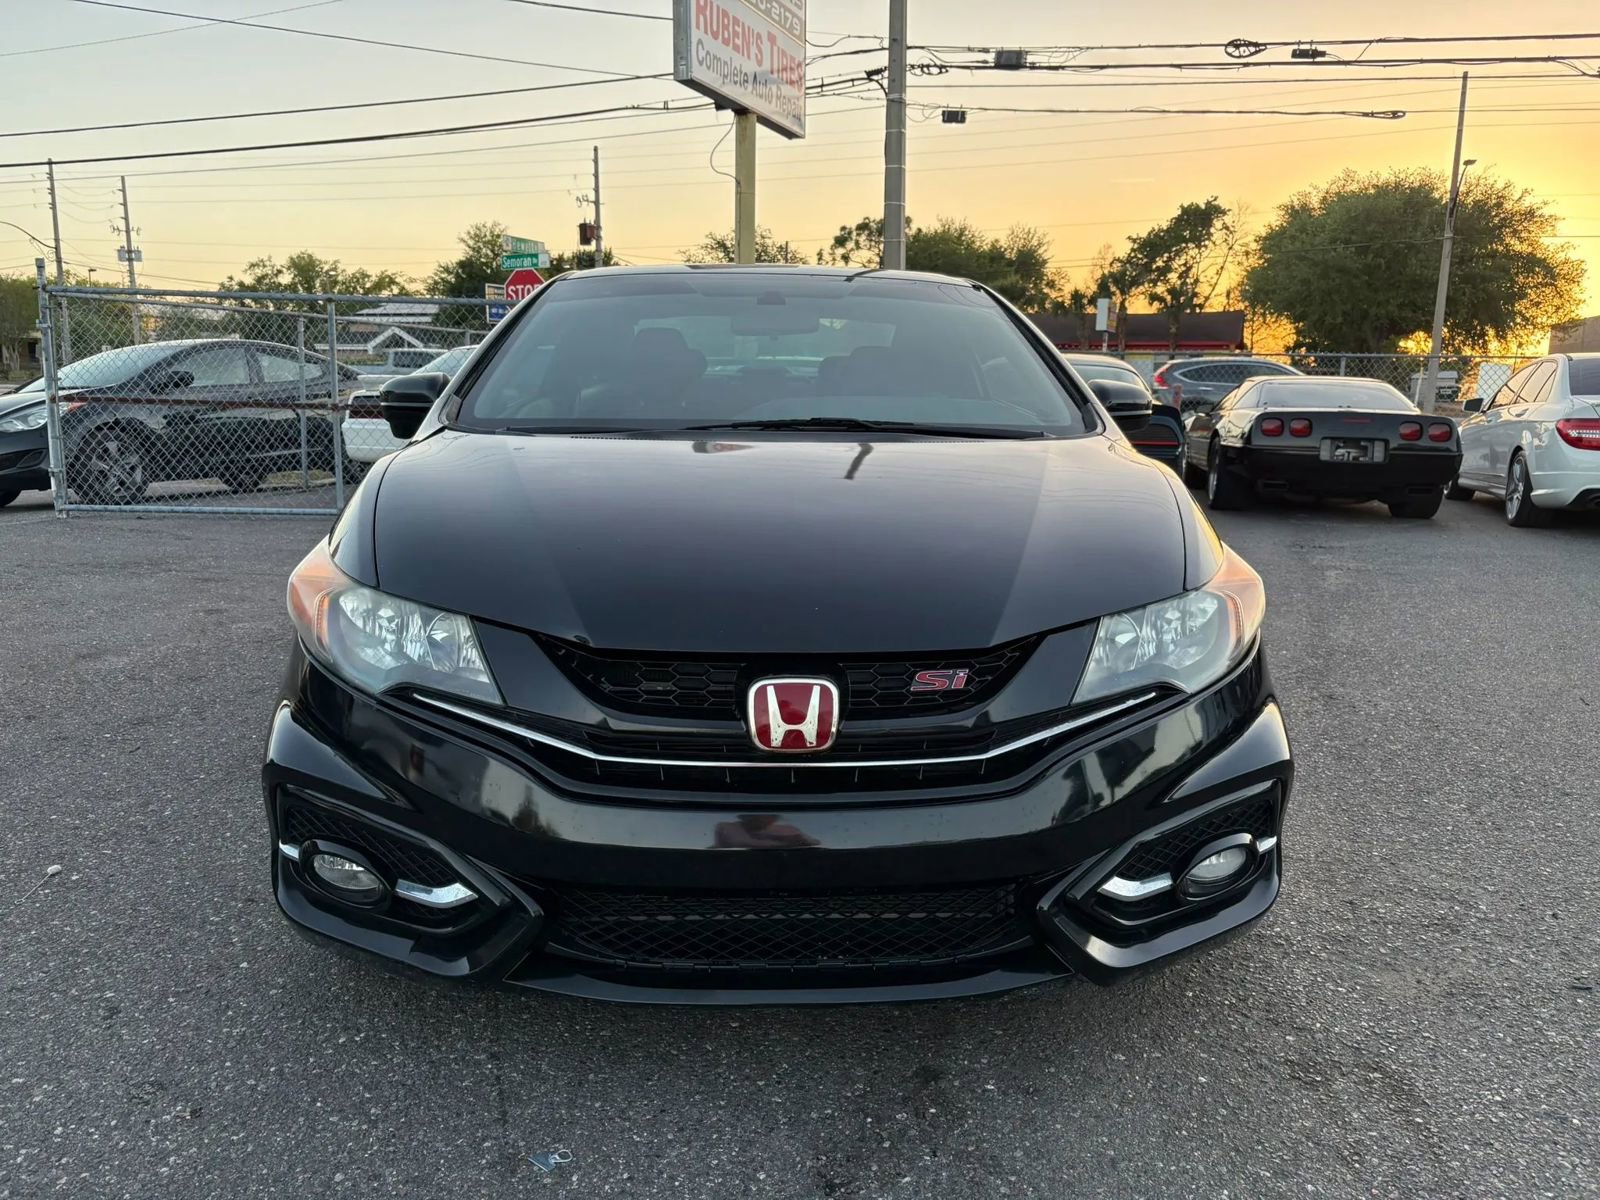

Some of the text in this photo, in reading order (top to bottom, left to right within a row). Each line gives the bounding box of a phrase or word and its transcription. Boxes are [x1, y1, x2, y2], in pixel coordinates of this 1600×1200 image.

[695, 0, 803, 94] RUBEN'S TIRES
[696, 38, 802, 121] Complete Auto Repair
